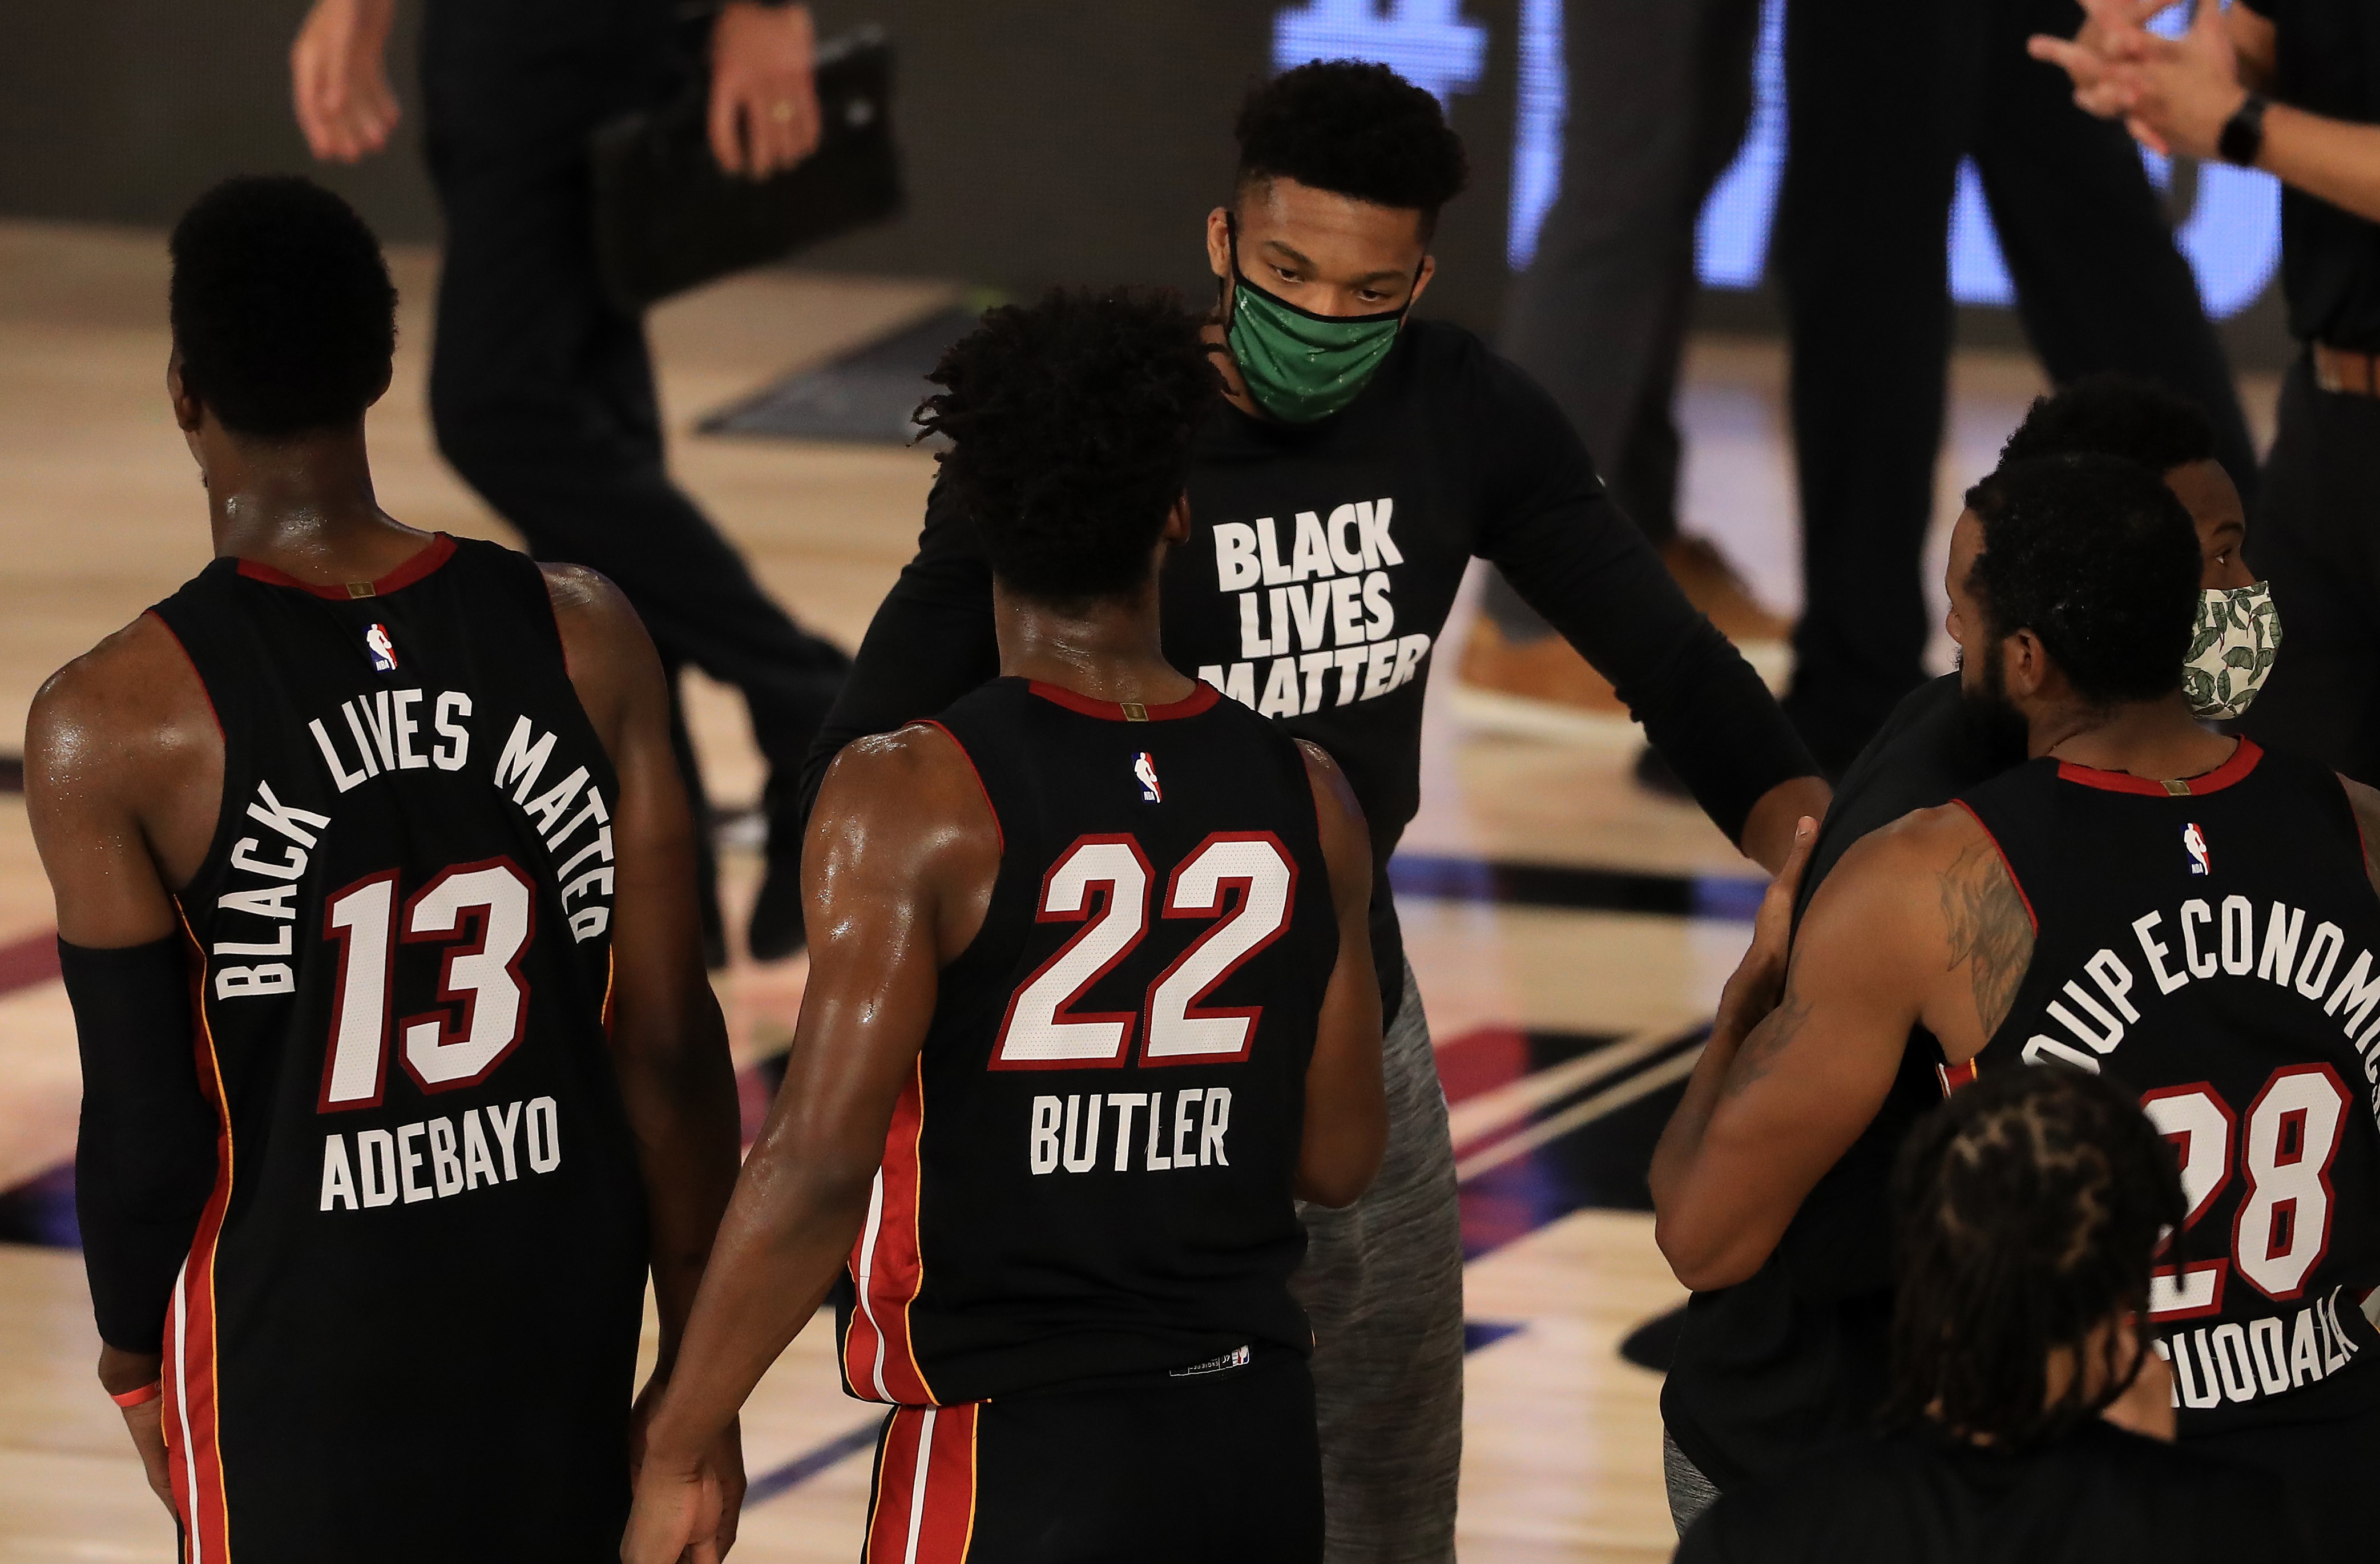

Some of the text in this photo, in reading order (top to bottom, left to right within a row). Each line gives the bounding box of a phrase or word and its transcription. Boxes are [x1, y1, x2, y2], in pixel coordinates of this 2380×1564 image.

[1213, 497, 1404, 592] BLACK
[376, 659, 390, 671] NBA
[1239, 571, 1395, 659] LIVES
[1198, 633, 1431, 719] MATTER
[213, 779, 332, 1001] BLACK
[308, 688, 473, 793] LIVES
[1143, 791, 1155, 801] NBA
[2191, 862, 2204, 874] NBA
[317, 853, 536, 1114] 13
[987, 830, 1298, 1071] 22
[2021, 948, 2141, 1077] OUP
[320, 1096, 561, 1211] ADEBAYO
[1030, 1087, 1232, 1175] BUTLER
[2139, 1062, 2353, 1323] 28
[2153, 1284, 2359, 1409] UODALA
